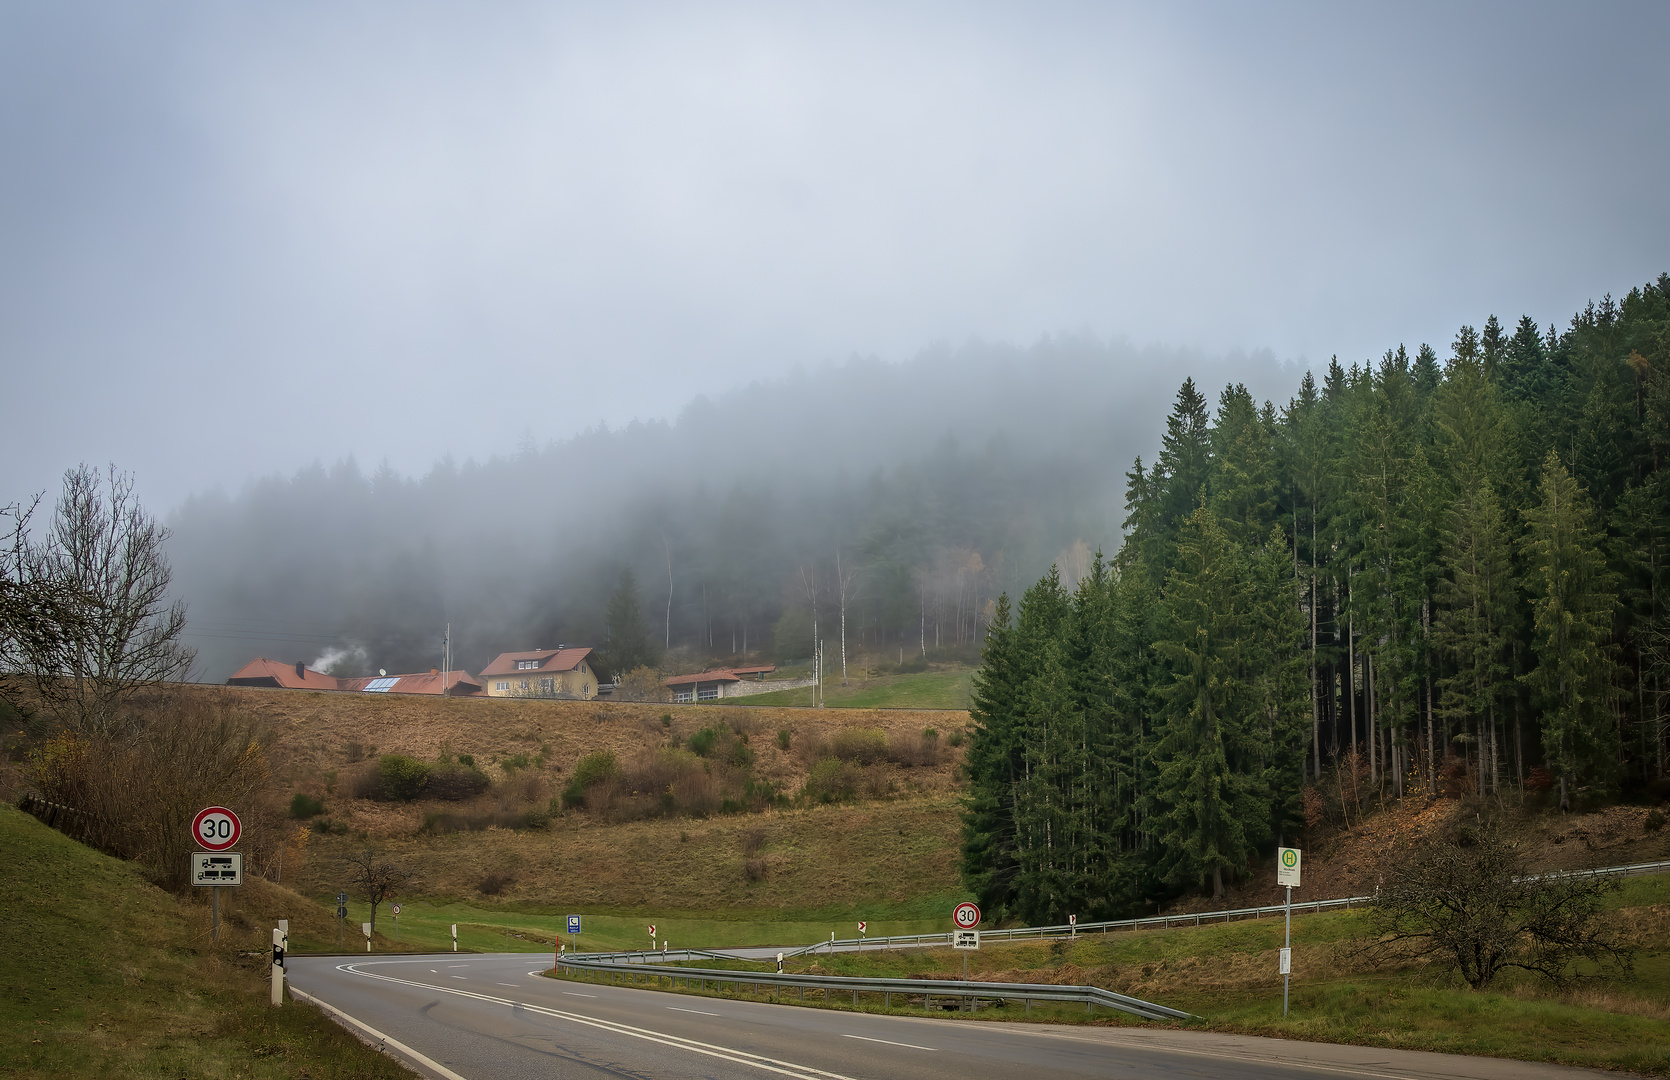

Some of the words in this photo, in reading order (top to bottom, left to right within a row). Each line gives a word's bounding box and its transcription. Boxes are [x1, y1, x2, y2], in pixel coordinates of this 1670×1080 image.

[203, 819, 231, 839] 30
[1286, 853, 1294, 864] H
[959, 909, 975, 922] 30
